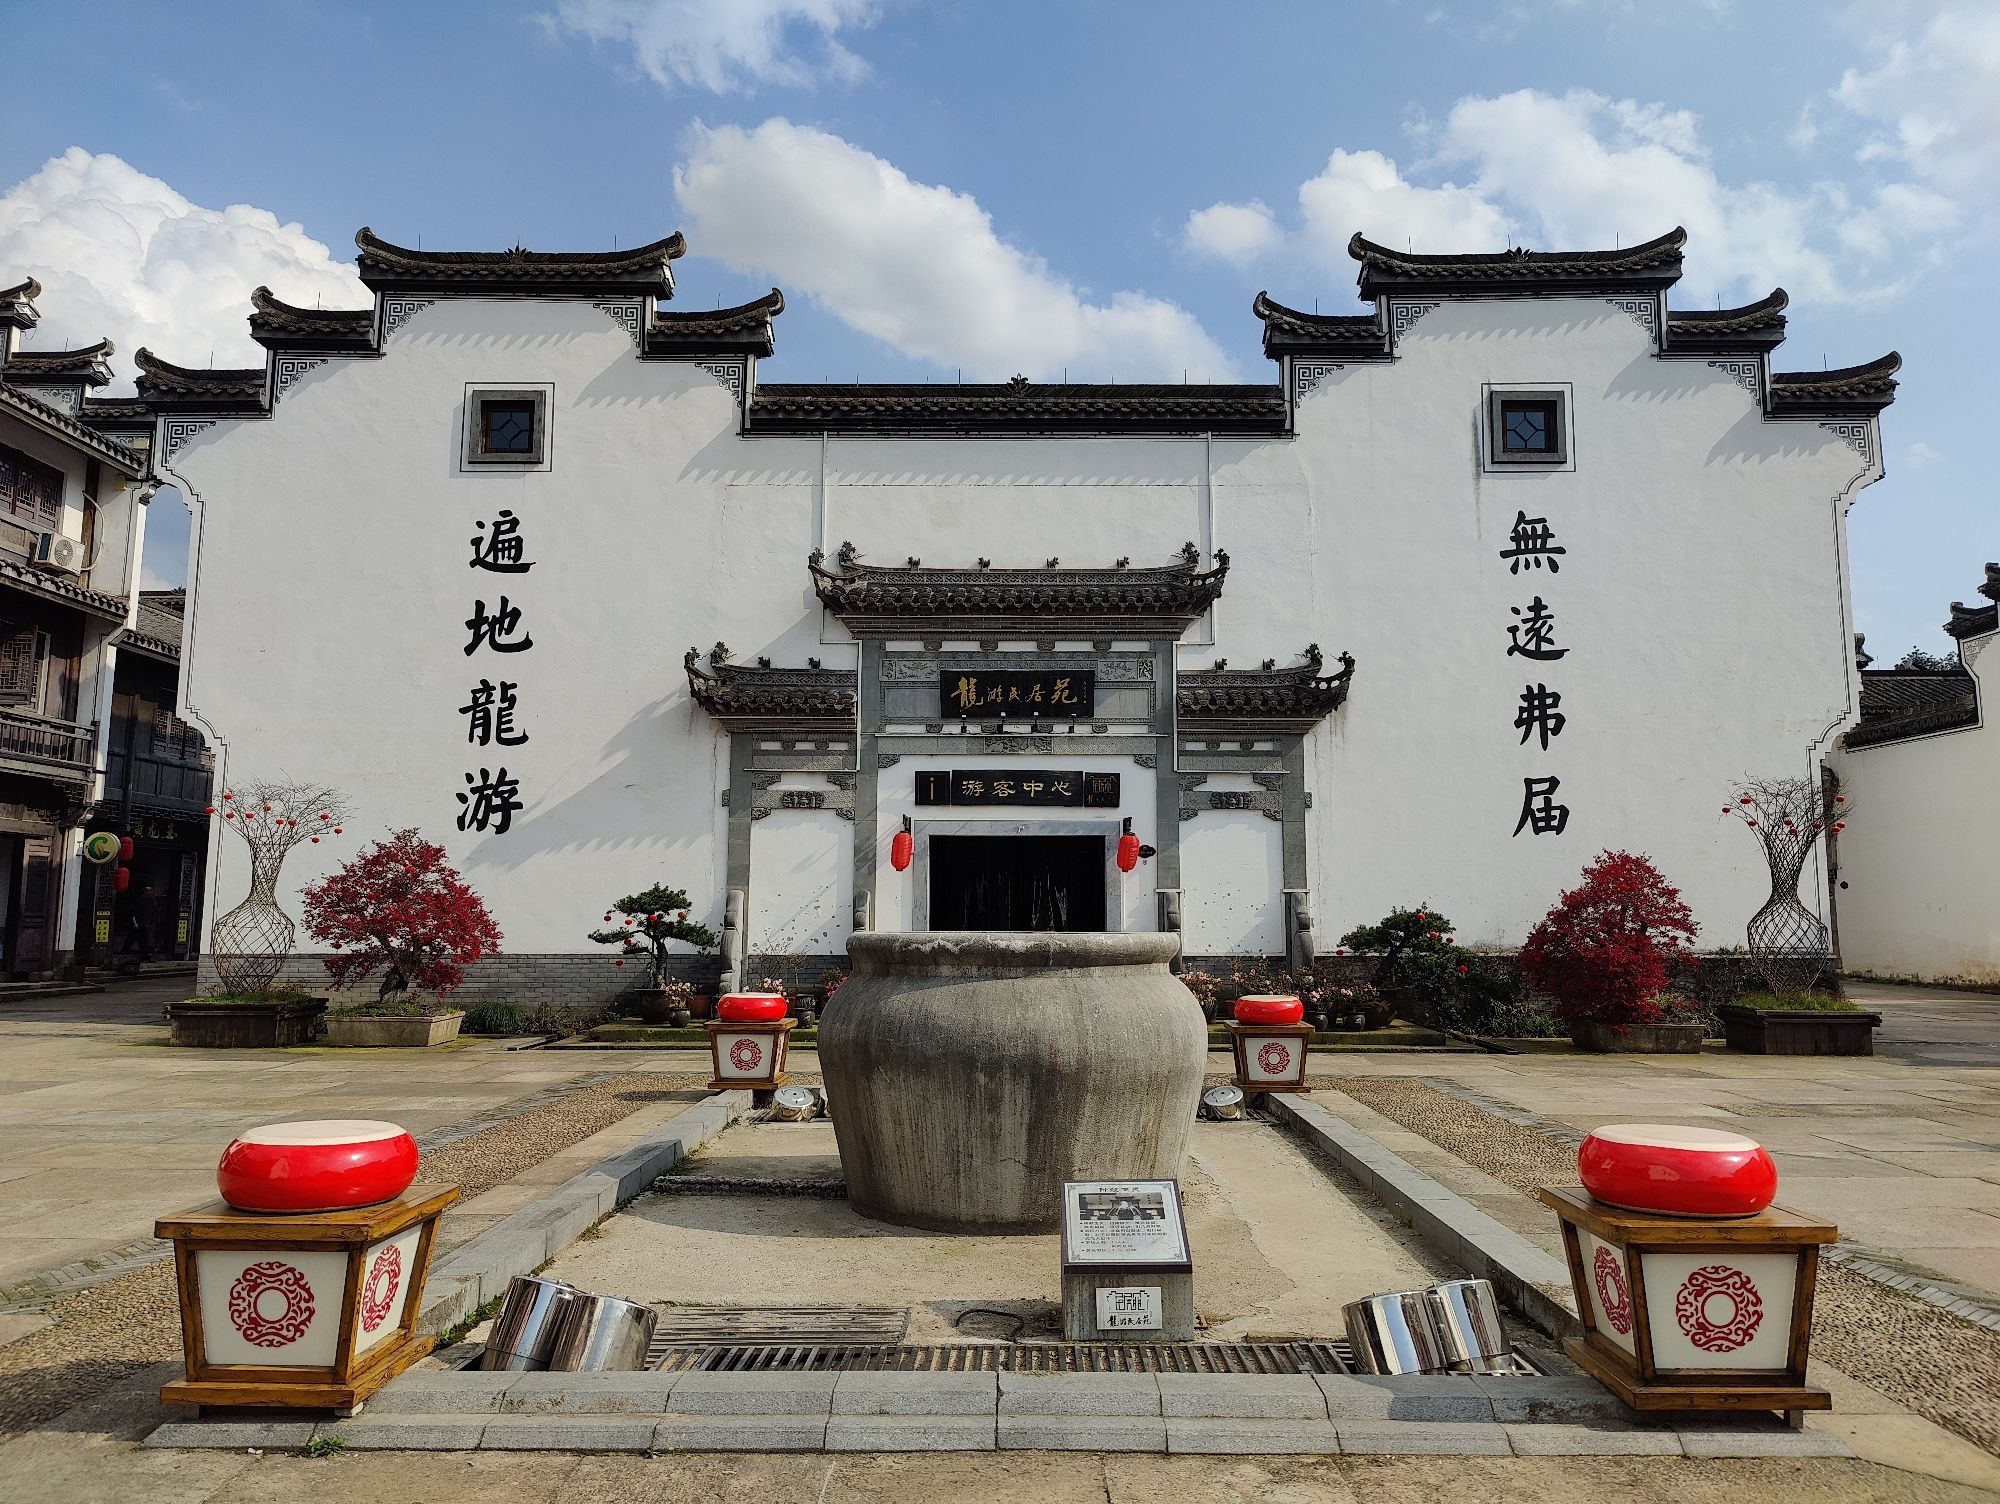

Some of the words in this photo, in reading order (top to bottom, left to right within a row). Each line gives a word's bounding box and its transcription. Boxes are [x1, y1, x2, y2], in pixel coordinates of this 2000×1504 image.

[456, 509, 536, 834] 遍地龍游
[961, 780, 1073, 798] 游客中心
